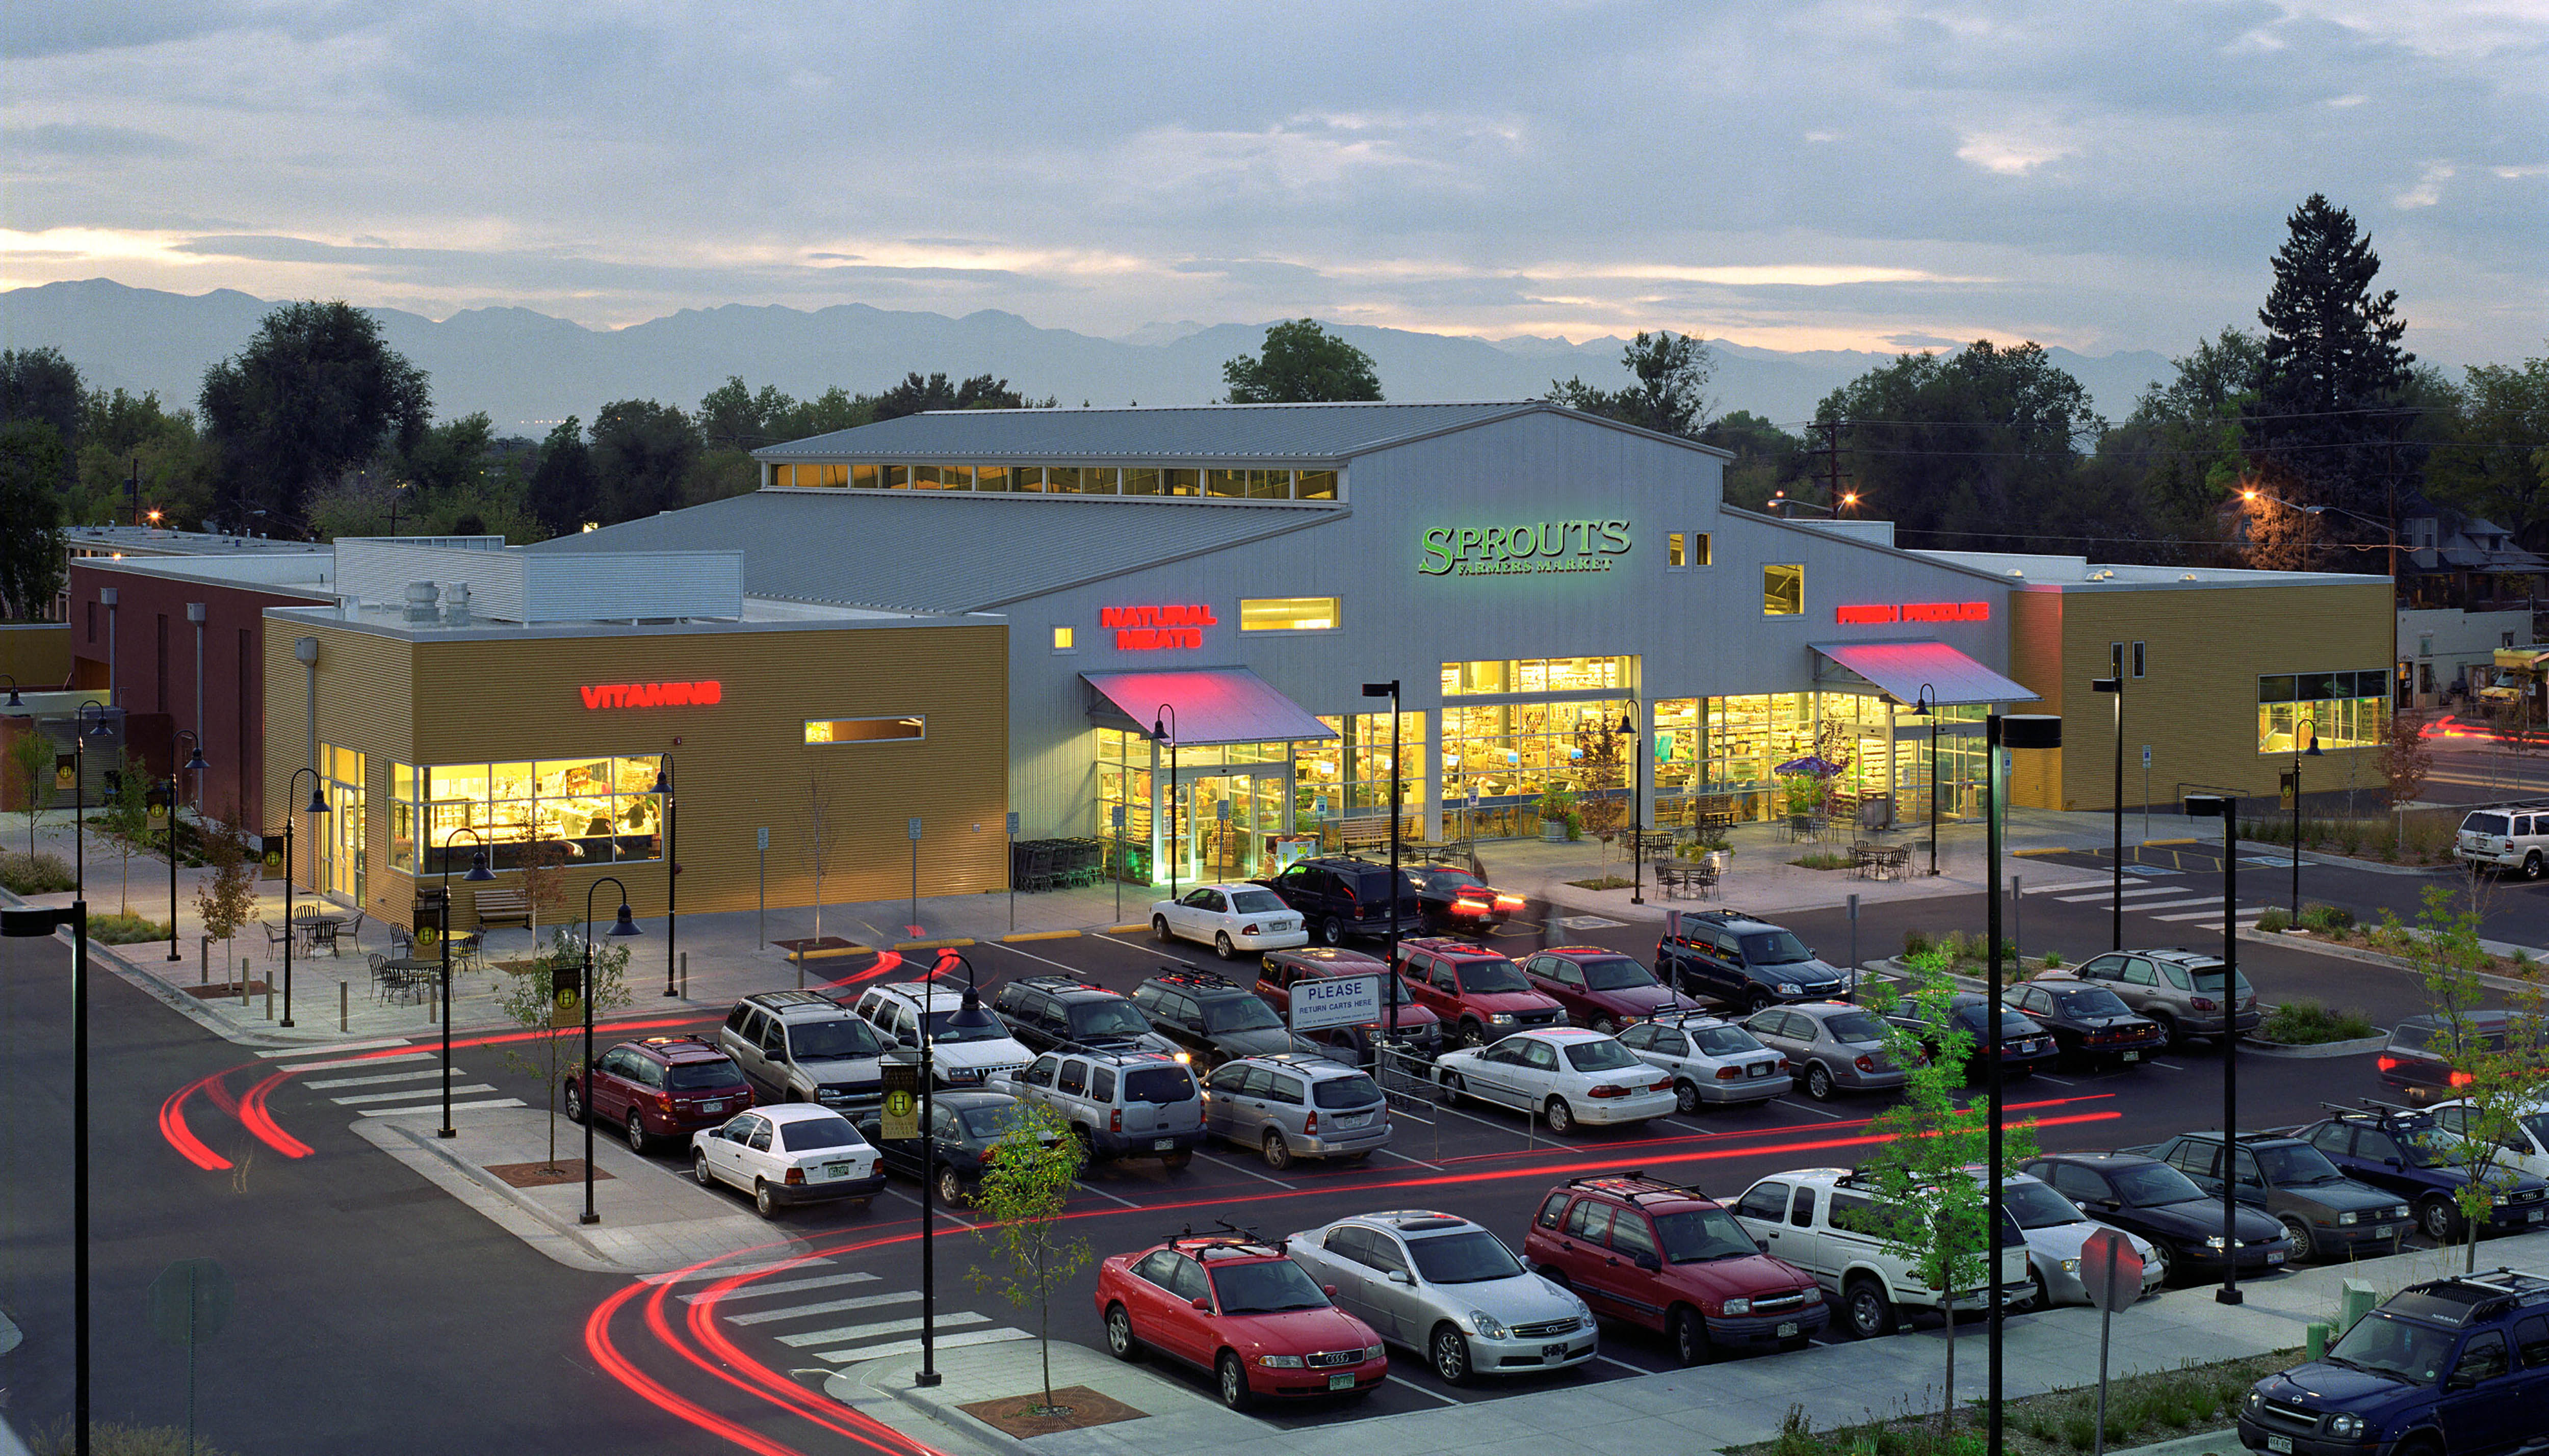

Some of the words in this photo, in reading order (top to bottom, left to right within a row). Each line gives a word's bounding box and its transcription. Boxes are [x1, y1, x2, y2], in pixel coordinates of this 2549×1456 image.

[1419, 519, 1631, 575] SPROUTS
[1458, 560, 1532, 576] FARMERS
[1537, 557, 1612, 574] MARKET
[1101, 604, 1217, 628] NATURAL
[1902, 602, 1989, 622] PRODUCE
[1116, 627, 1202, 650] MEATS
[580, 681, 721, 709] VITAMINS
[421, 929, 432, 941] H
[561, 992, 573, 1004] H
[1308, 982, 1362, 1000] PLEASE
[1300, 1004, 1326, 1014] RETURN
[1329, 1001, 1352, 1011] CARTS
[1355, 998, 1372, 1007] HERE
[892, 1094, 906, 1110] H
[2431, 1313, 2459, 1323] NISSAN
